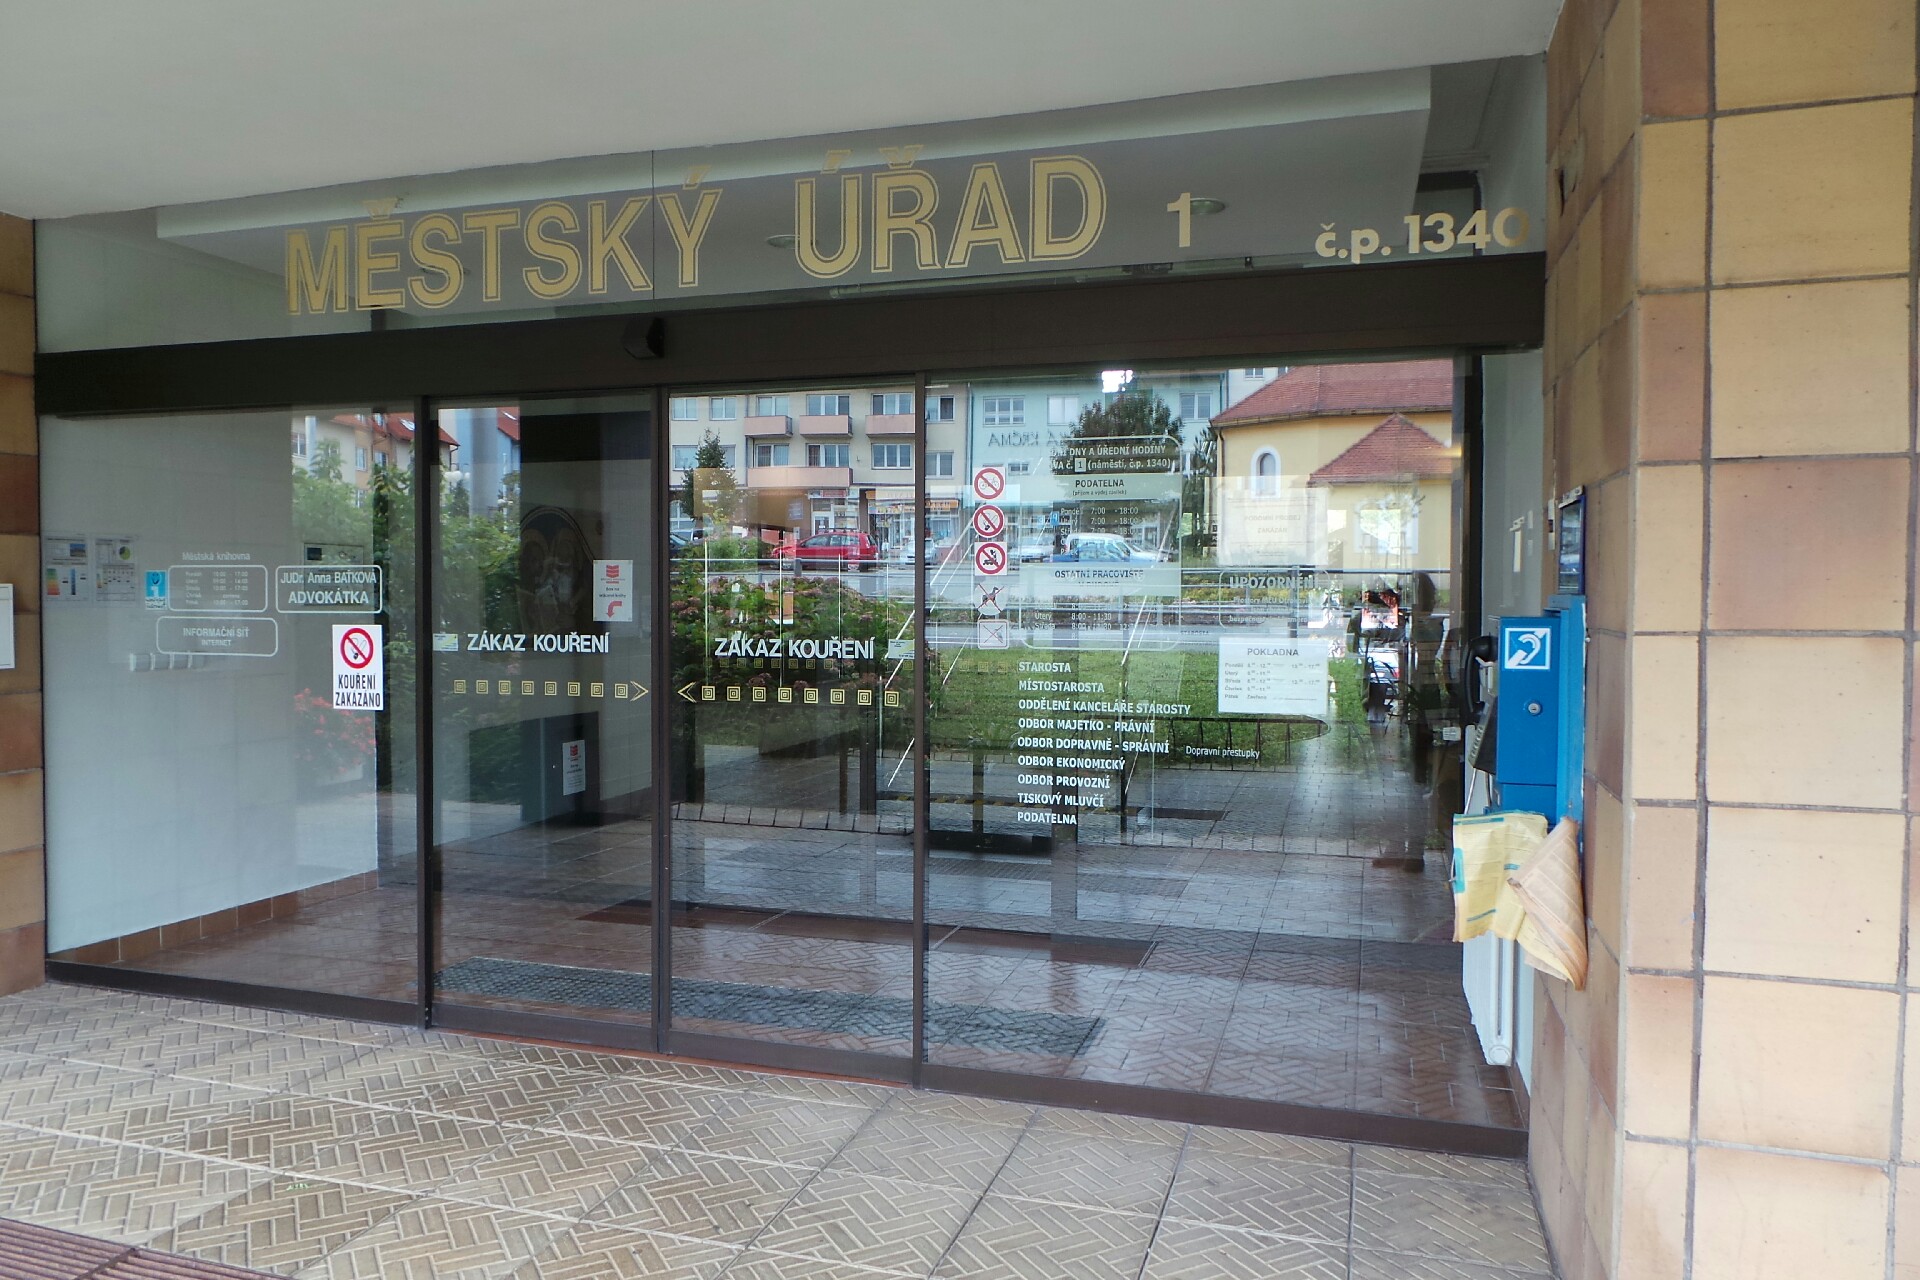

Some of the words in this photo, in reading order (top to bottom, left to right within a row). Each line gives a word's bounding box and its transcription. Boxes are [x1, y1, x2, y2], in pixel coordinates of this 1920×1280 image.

[1166, 192, 1191, 248] 1
[285, 166, 724, 317] MĚSTSKÝ
[794, 145, 1107, 280] ÚŘAD
[1314, 222, 1393, 265] č.p.
[1403, 207, 1531, 254] 1340
[1069, 447, 1087, 456] DNY
[1088, 447, 1095, 456] A
[1097, 443, 1130, 455] ÚŘEDNÍ
[1146, 458, 1171, 469] 1340)
[1075, 479, 1125, 488] PODATELNA
[1090, 507, 1106, 515] 7:00
[1119, 507, 1139, 515] 18:00
[216, 550, 251, 561] knihovna
[280, 572, 304, 584] JUDr.
[307, 572, 331, 584] Anna
[288, 587, 369, 604] ADVOKÁTKA
[183, 626, 235, 638] INFORMAČNÍ
[467, 630, 526, 651] ZÁKAZ
[533, 631, 610, 653] KOUŘENÍ
[714, 631, 783, 658] ZÁKAZ
[788, 635, 875, 659] KOUŘENÍ
[1247, 648, 1299, 656] POKLADNA
[1018, 661, 1071, 673] STAROSTA
[338, 672, 376, 690] KOUŘENÍ
[1018, 679, 1105, 693] MÍSTOSTAROSTA
[335, 689, 381, 707] ZAKÁZÁNO
[1018, 697, 1070, 711] ODDĚLENÍ
[1073, 698, 1134, 713] KANCELÁŘE
[1136, 703, 1191, 715] STAROSTY
[1018, 718, 1054, 729] ODBOR
[1057, 719, 1104, 731] MAJETKO
[1114, 718, 1155, 733] PRÁVNÍ
[1017, 736, 1054, 748] ODBOR
[1056, 735, 1112, 751] DOPRAVNĚ
[1122, 738, 1170, 754] SPRÁVNÍ
[1185, 745, 1220, 757] Dopravní
[1222, 747, 1260, 760] přestupky
[1017, 755, 1054, 767] ODBOR
[1056, 755, 1126, 770] EKONOMICKÝ
[1017, 774, 1054, 785] ODBOR
[1056, 776, 1110, 789] PROVOZNÍ
[1017, 791, 1062, 805] TISKOVÝ
[1064, 793, 1104, 807] MLUVČÍ
[1017, 811, 1077, 825] PODATELNA
